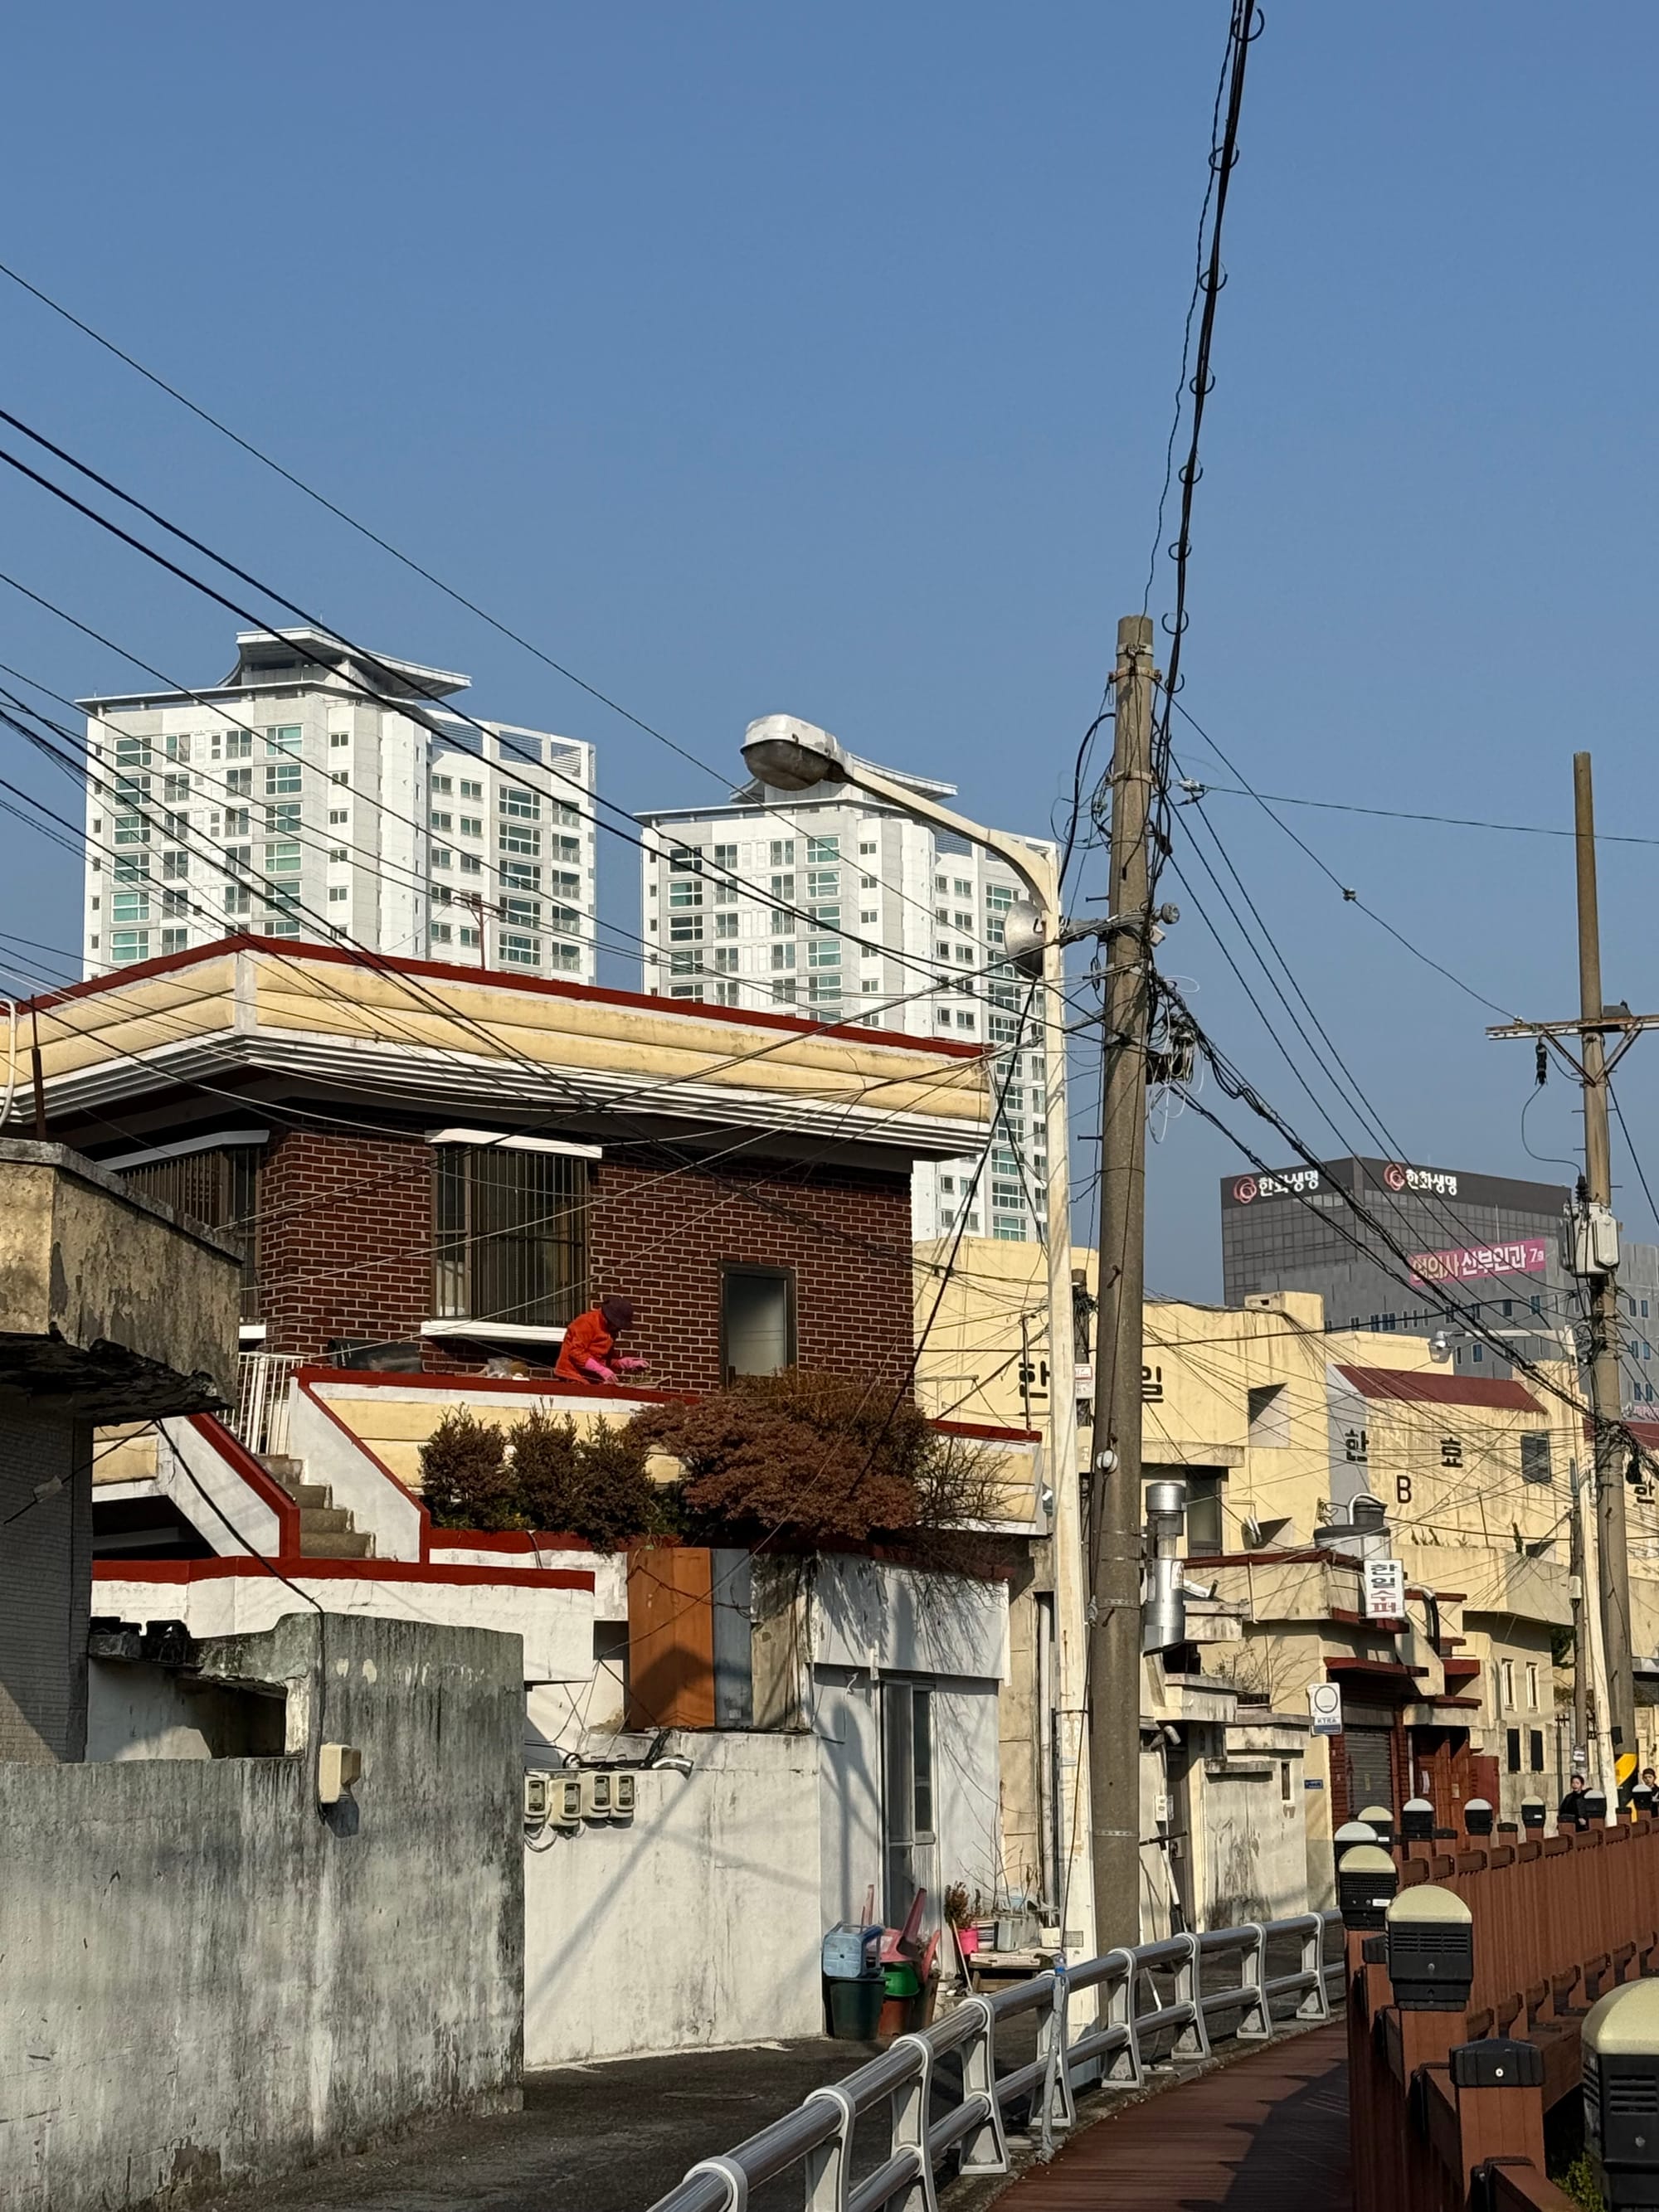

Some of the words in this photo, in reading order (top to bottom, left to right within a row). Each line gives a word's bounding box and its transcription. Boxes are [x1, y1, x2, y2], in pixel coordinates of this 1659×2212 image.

[1405, 1168, 1457, 1196] 한화생명
[1461, 1245, 1526, 1276] 산부인과
[1019, 1360, 1050, 1399] 한
[1345, 1428, 1370, 1462] 한
[1396, 1475, 1412, 1505] B
[1370, 1563, 1398, 1613] 한일수퍼
